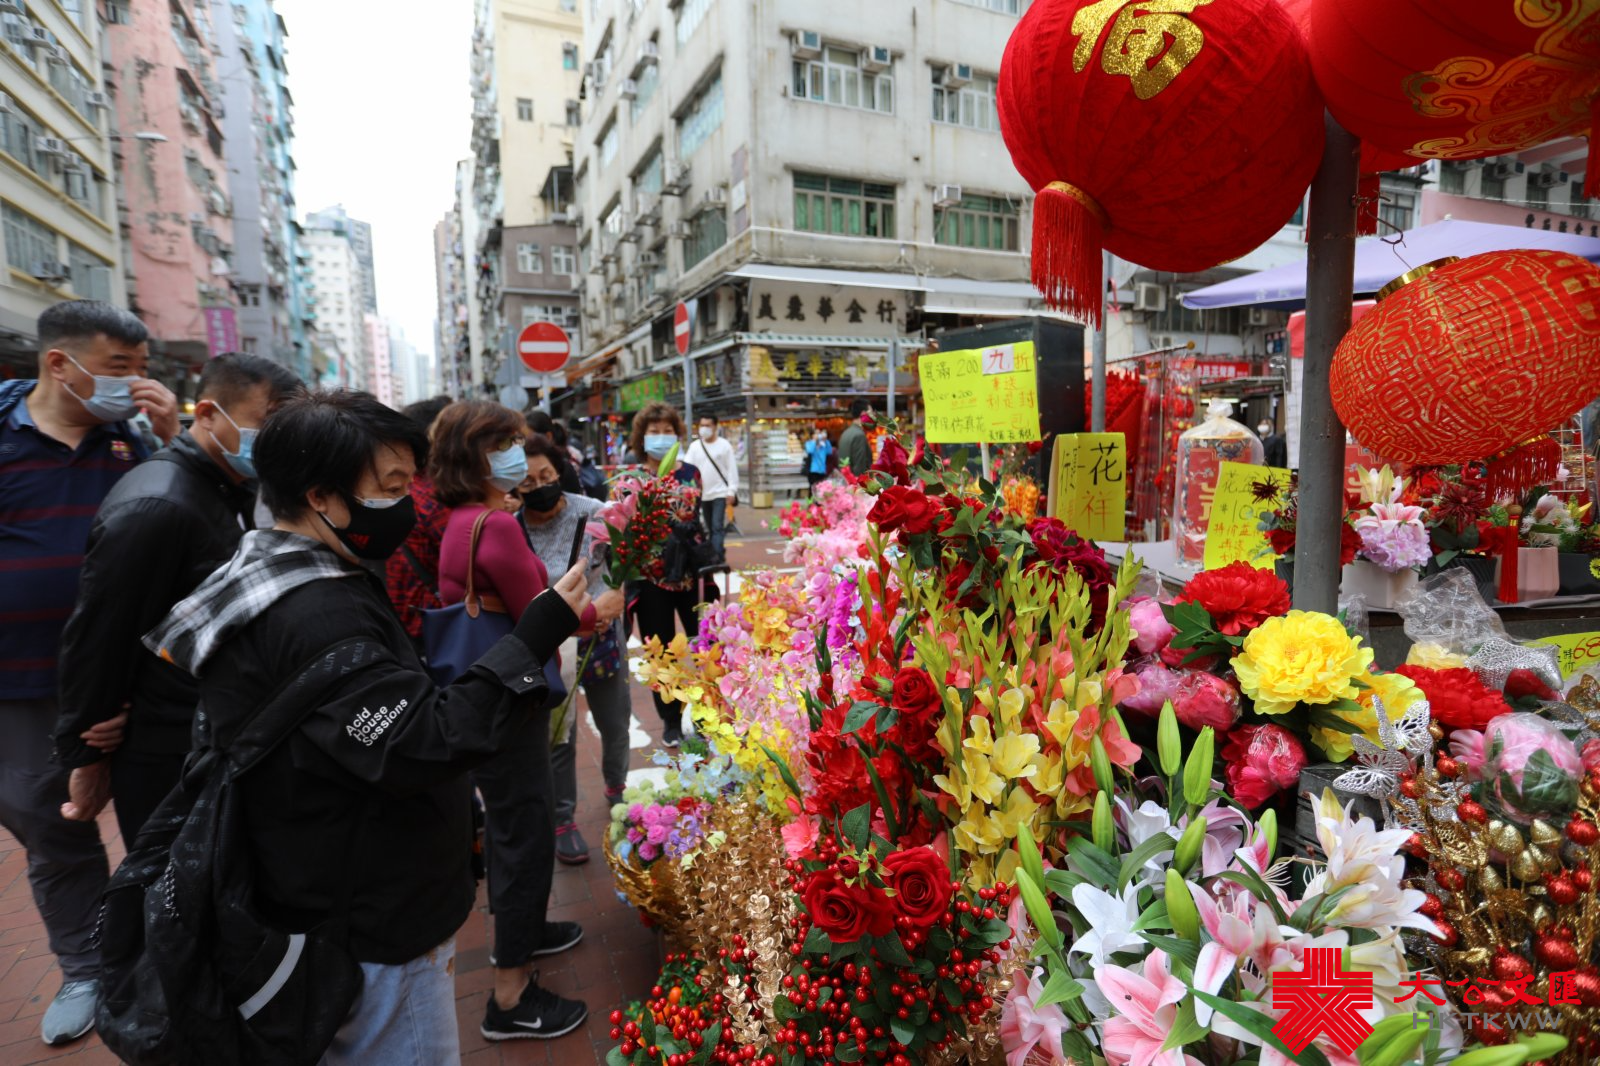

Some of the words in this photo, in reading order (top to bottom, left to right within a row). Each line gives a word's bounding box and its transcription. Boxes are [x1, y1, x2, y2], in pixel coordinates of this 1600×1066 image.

[345, 707, 371, 736] Acid
[353, 705, 388, 741] House
[362, 698, 408, 746] Sessions
